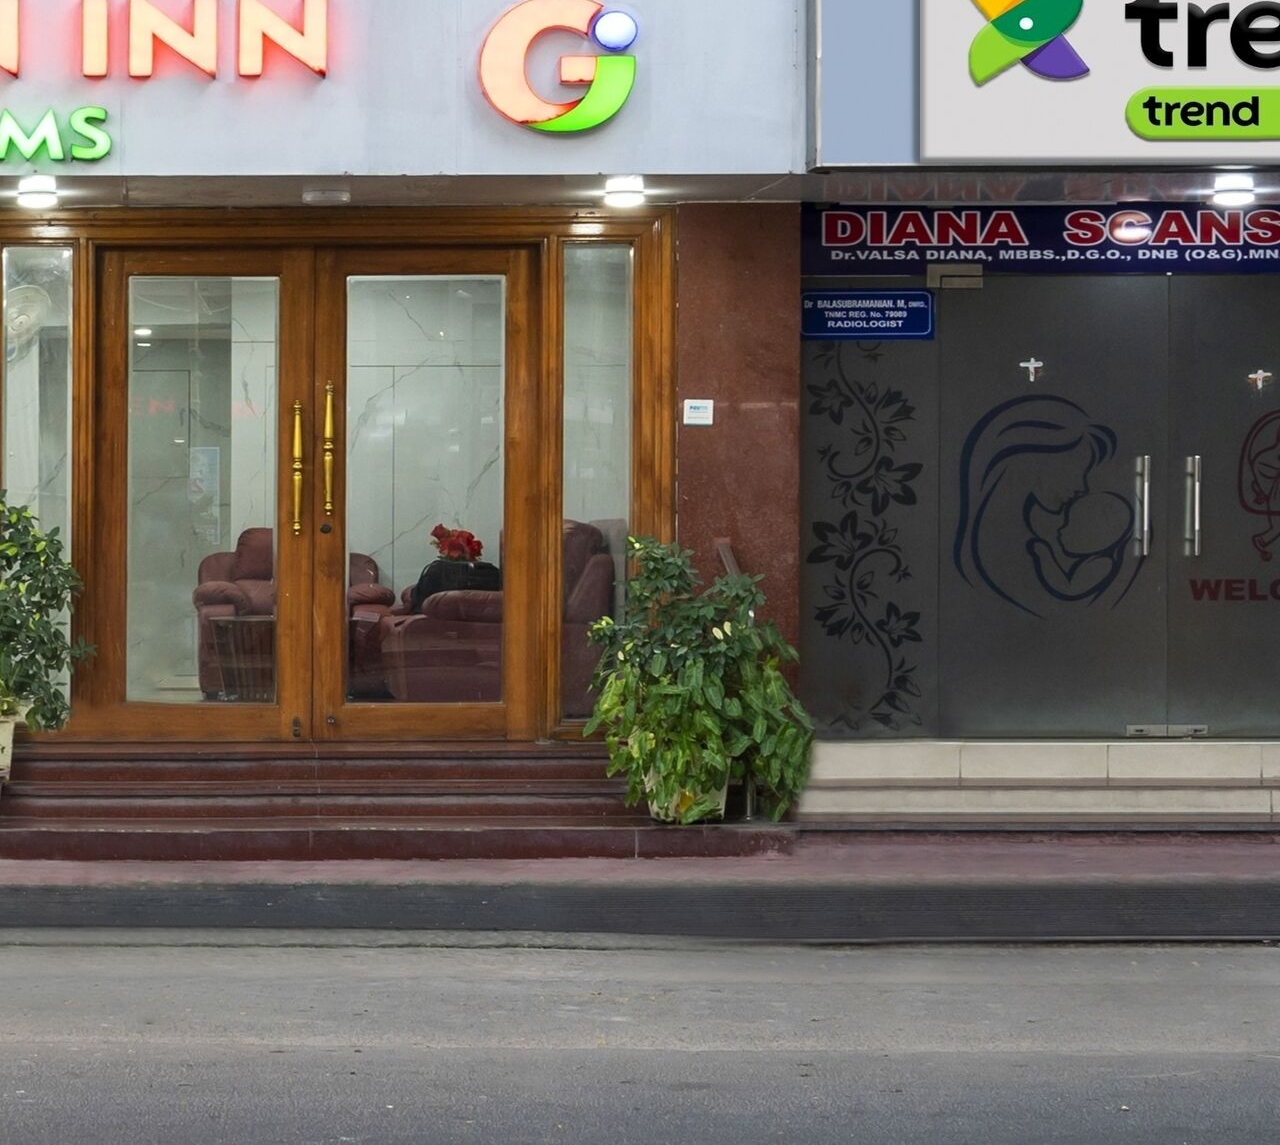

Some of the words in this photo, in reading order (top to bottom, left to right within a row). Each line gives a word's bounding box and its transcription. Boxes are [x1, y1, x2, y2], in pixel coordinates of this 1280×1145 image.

[1142, 95, 1260, 127] trend
[821, 211, 1029, 247] DIANA
[926, 250, 993, 263] DIANA,
[1138, 249, 1178, 260] DNB
[827, 320, 904, 329] RADIOLOGIST
